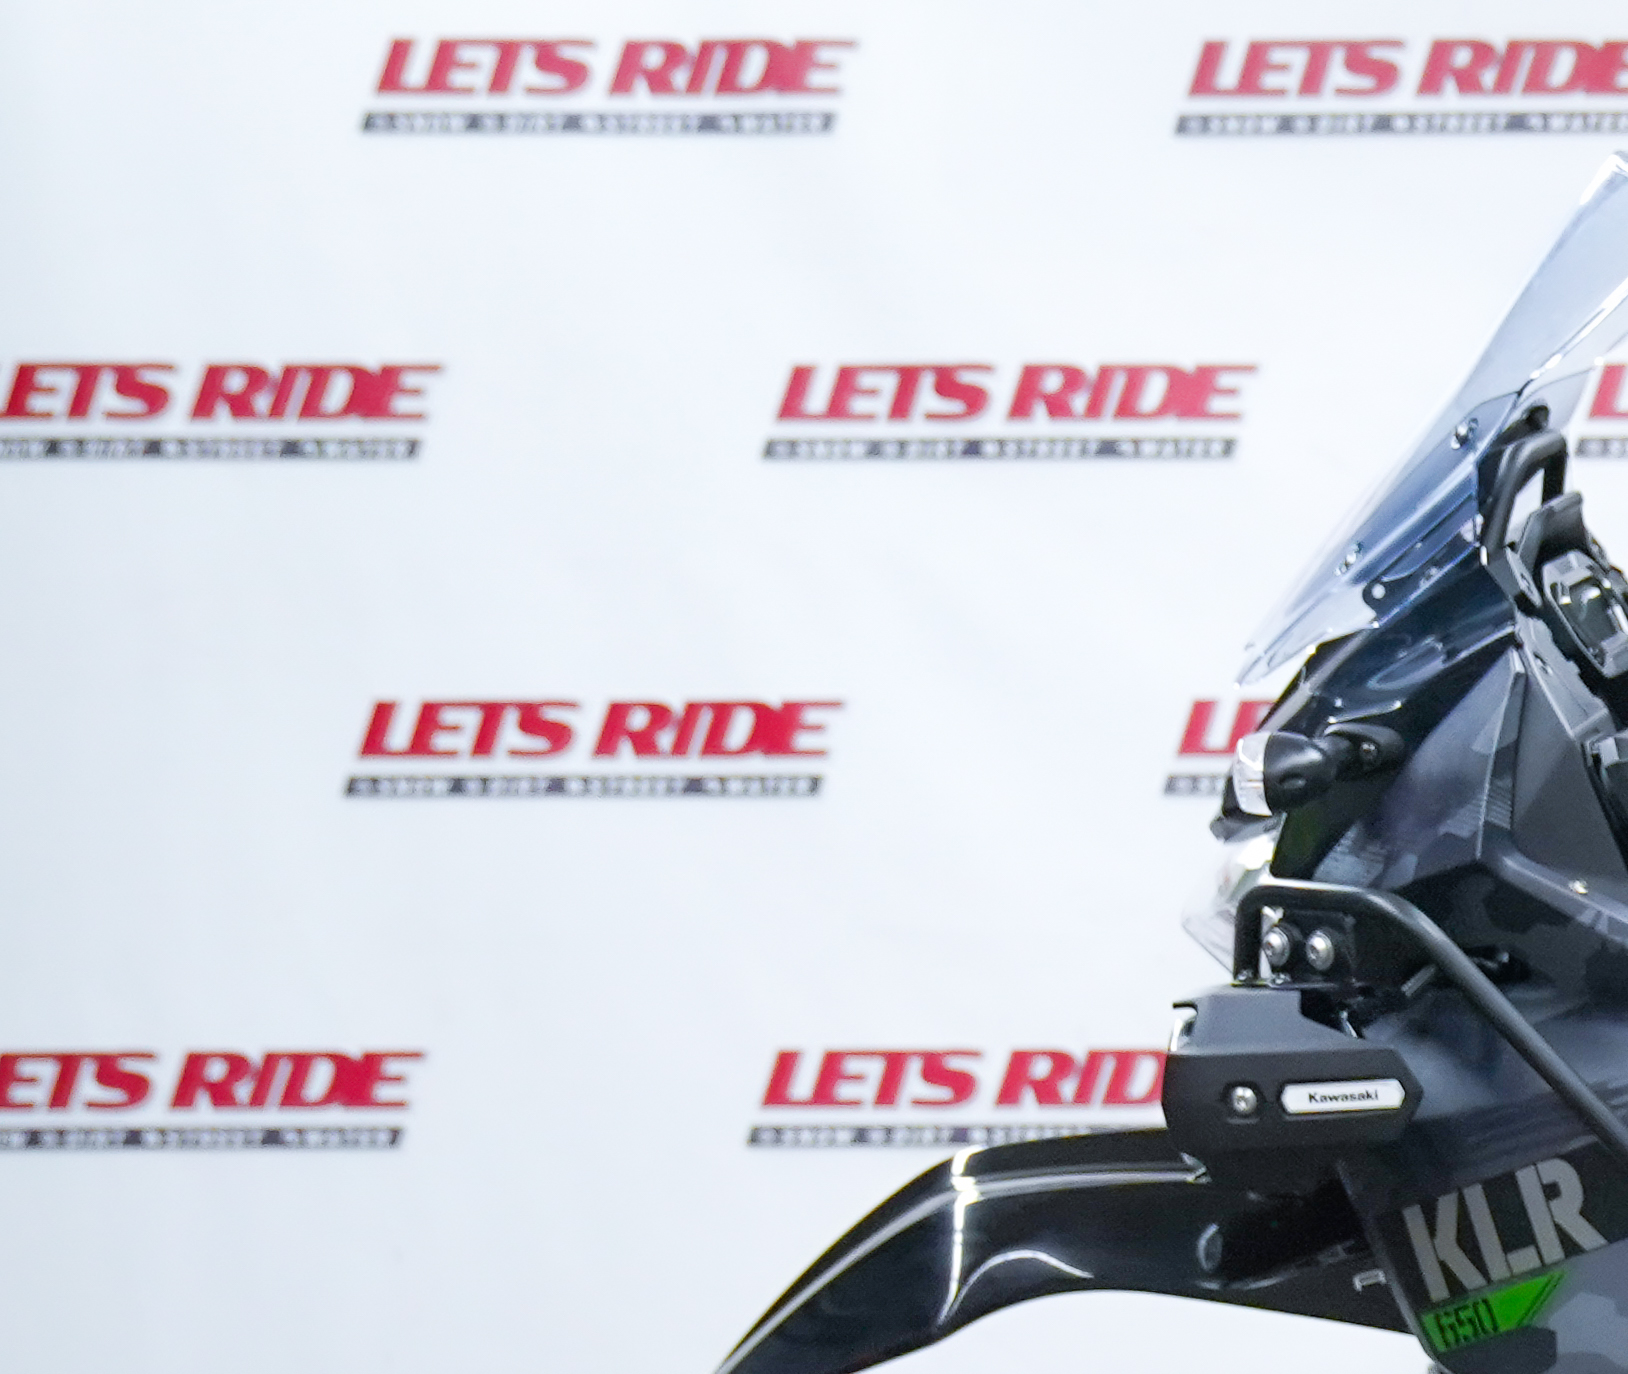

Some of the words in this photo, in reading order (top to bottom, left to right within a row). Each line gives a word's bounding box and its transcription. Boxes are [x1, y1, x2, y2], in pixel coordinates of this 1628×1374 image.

[378, 40, 592, 94] LETS
[611, 40, 857, 94] RIDE
[1191, 41, 1403, 95] LETS
[191, 364, 441, 420] RIDE
[778, 365, 992, 420] LETS
[1009, 365, 1252, 420] RIDE
[360, 701, 578, 757] LETS
[594, 701, 842, 757] RIDE
[0, 1053, 155, 1110] ETS
[171, 1052, 423, 1109] RIDE
[763, 1050, 981, 1107] LETS
[995, 1050, 1169, 1106] RID
[1308, 1090, 1379, 1104] Kawasaki
[1402, 1158, 1607, 1303] KLR
[1434, 1298, 1499, 1351] 650
